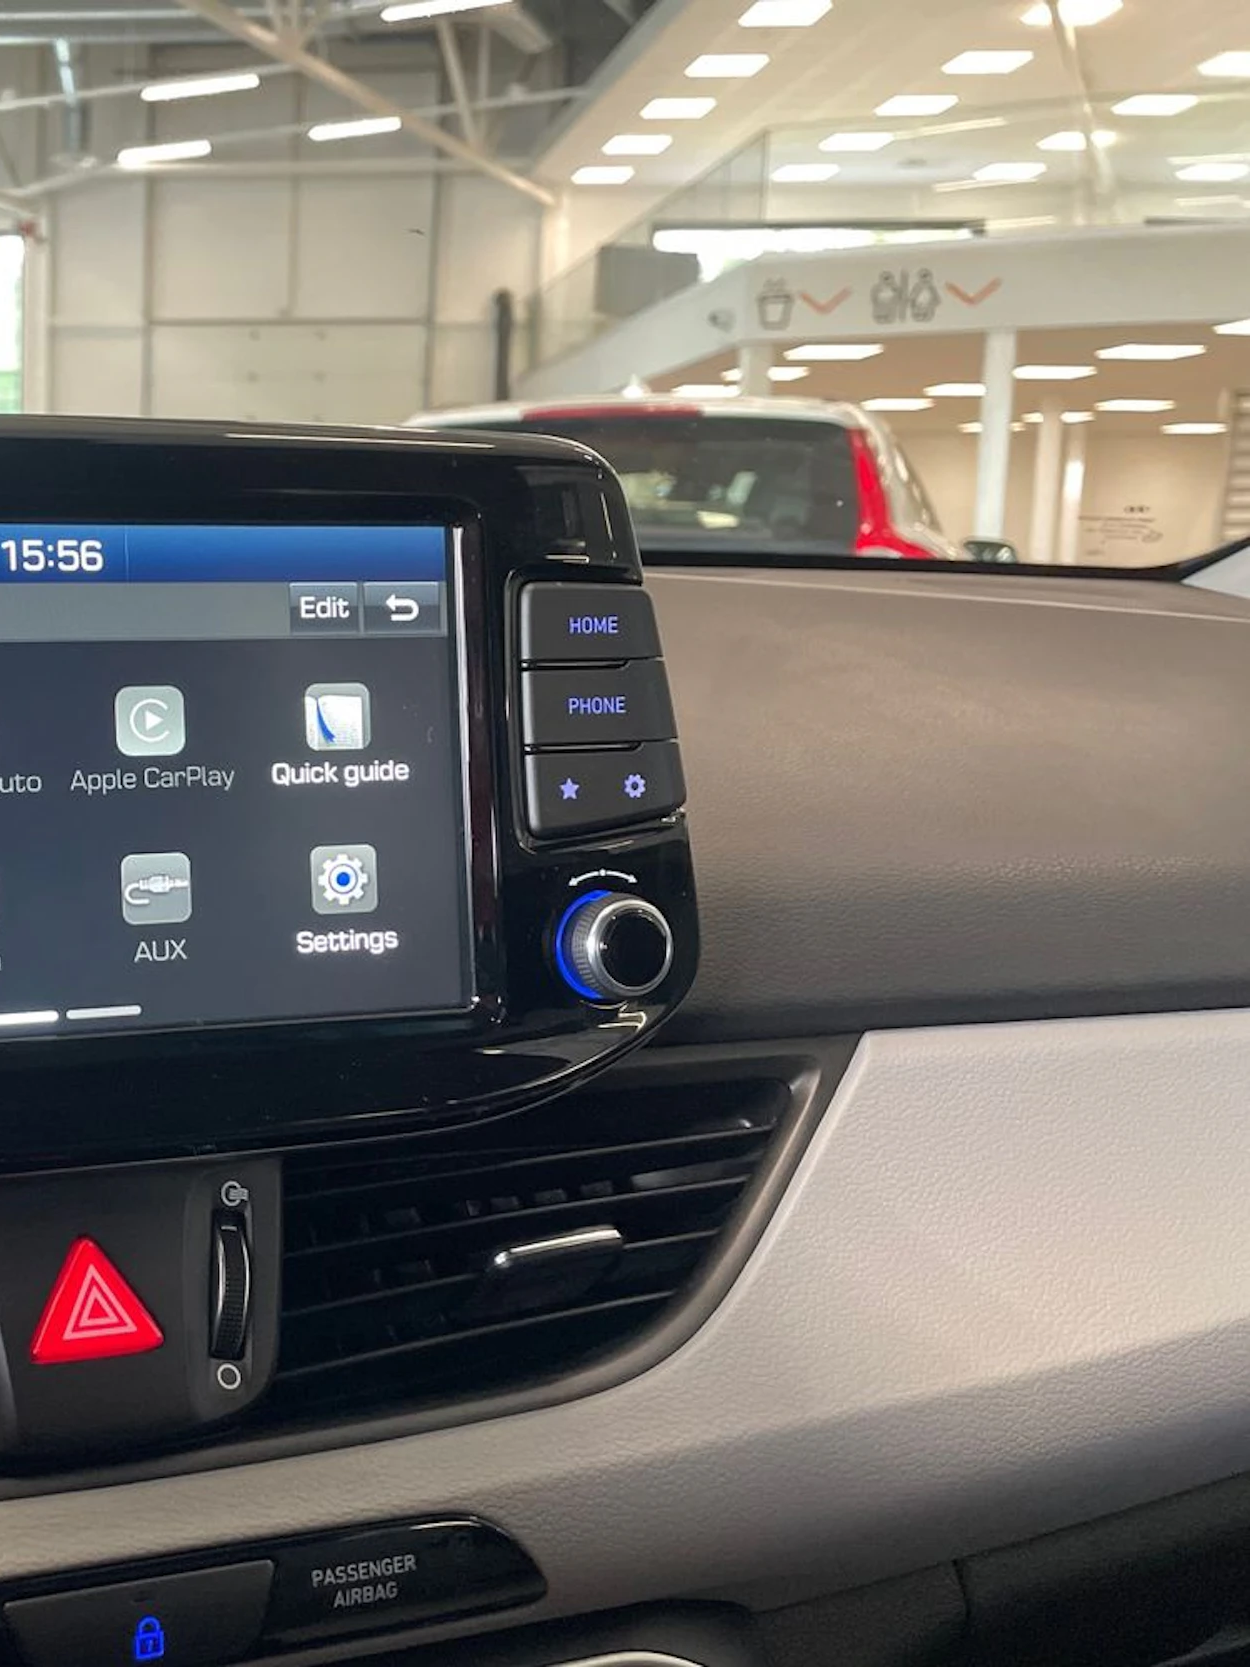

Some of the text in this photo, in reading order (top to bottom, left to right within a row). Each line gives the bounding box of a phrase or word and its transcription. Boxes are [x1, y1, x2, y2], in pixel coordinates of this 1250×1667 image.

[0, 538, 104, 573] 15:56
[299, 596, 350, 620] Edit
[568, 615, 619, 636] HOME
[567, 695, 627, 716] PHONE
[69, 766, 235, 794] Apple CarPlay
[271, 759, 411, 789] Quick guide
[133, 938, 188, 964] AUX
[295, 930, 400, 956] Settings
[310, 1554, 417, 1588] PASSENGER
[332, 1579, 399, 1608] AIRBAG
